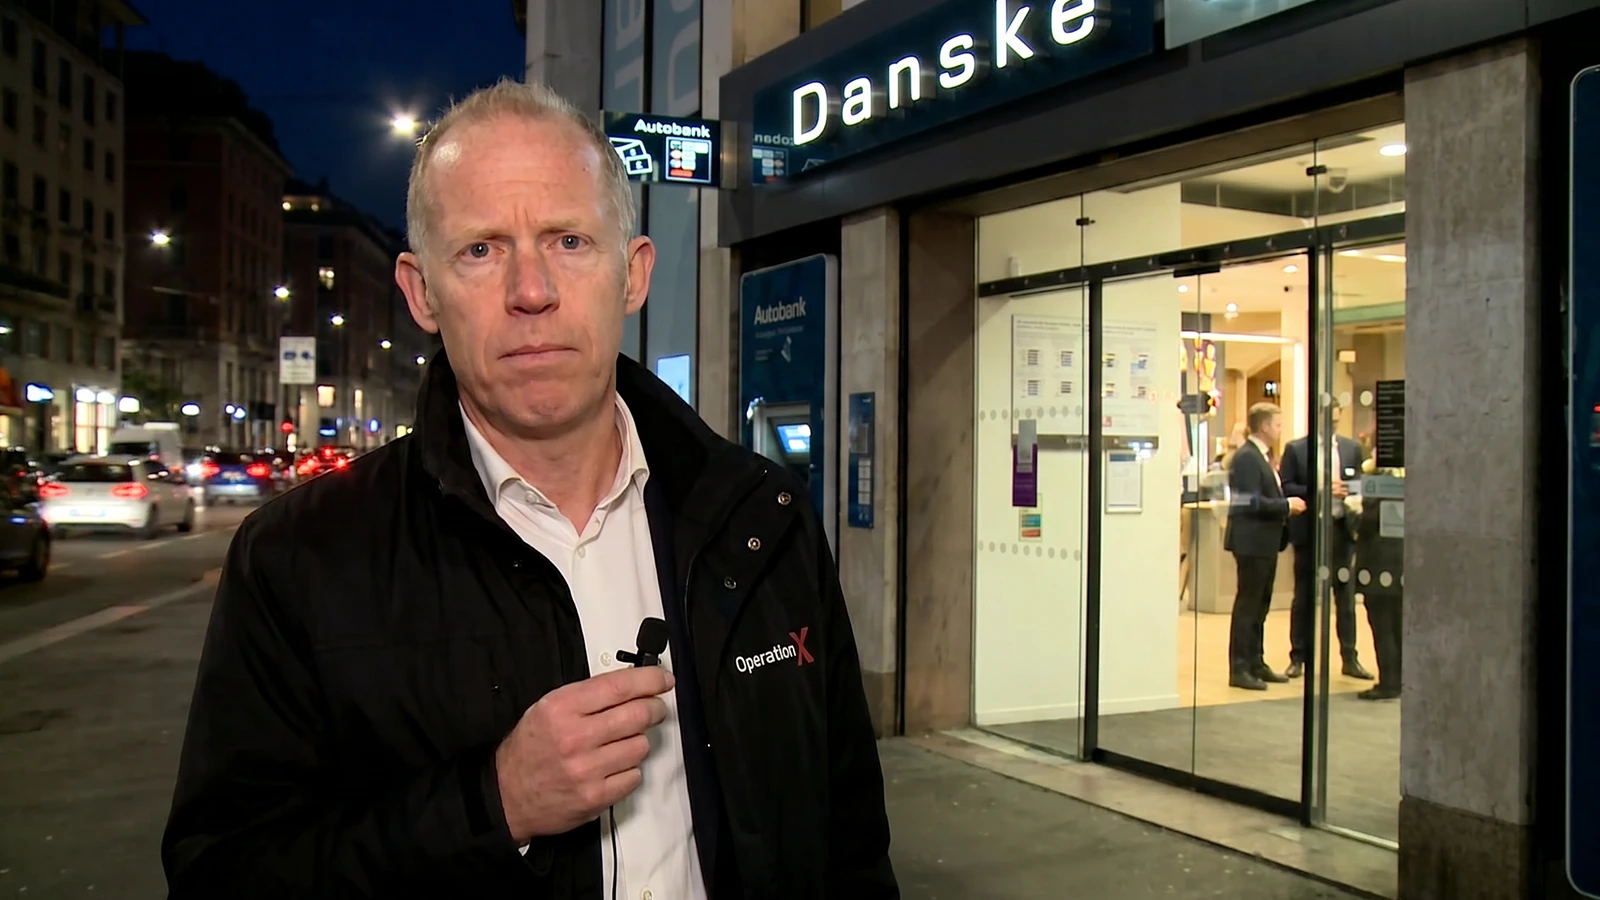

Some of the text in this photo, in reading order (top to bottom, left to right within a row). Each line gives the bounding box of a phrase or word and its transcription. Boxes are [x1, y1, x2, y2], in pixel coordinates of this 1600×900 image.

[793, 0, 1095, 146] Danske
[634, 118, 711, 139] Autobank
[754, 296, 806, 325] Autobank
